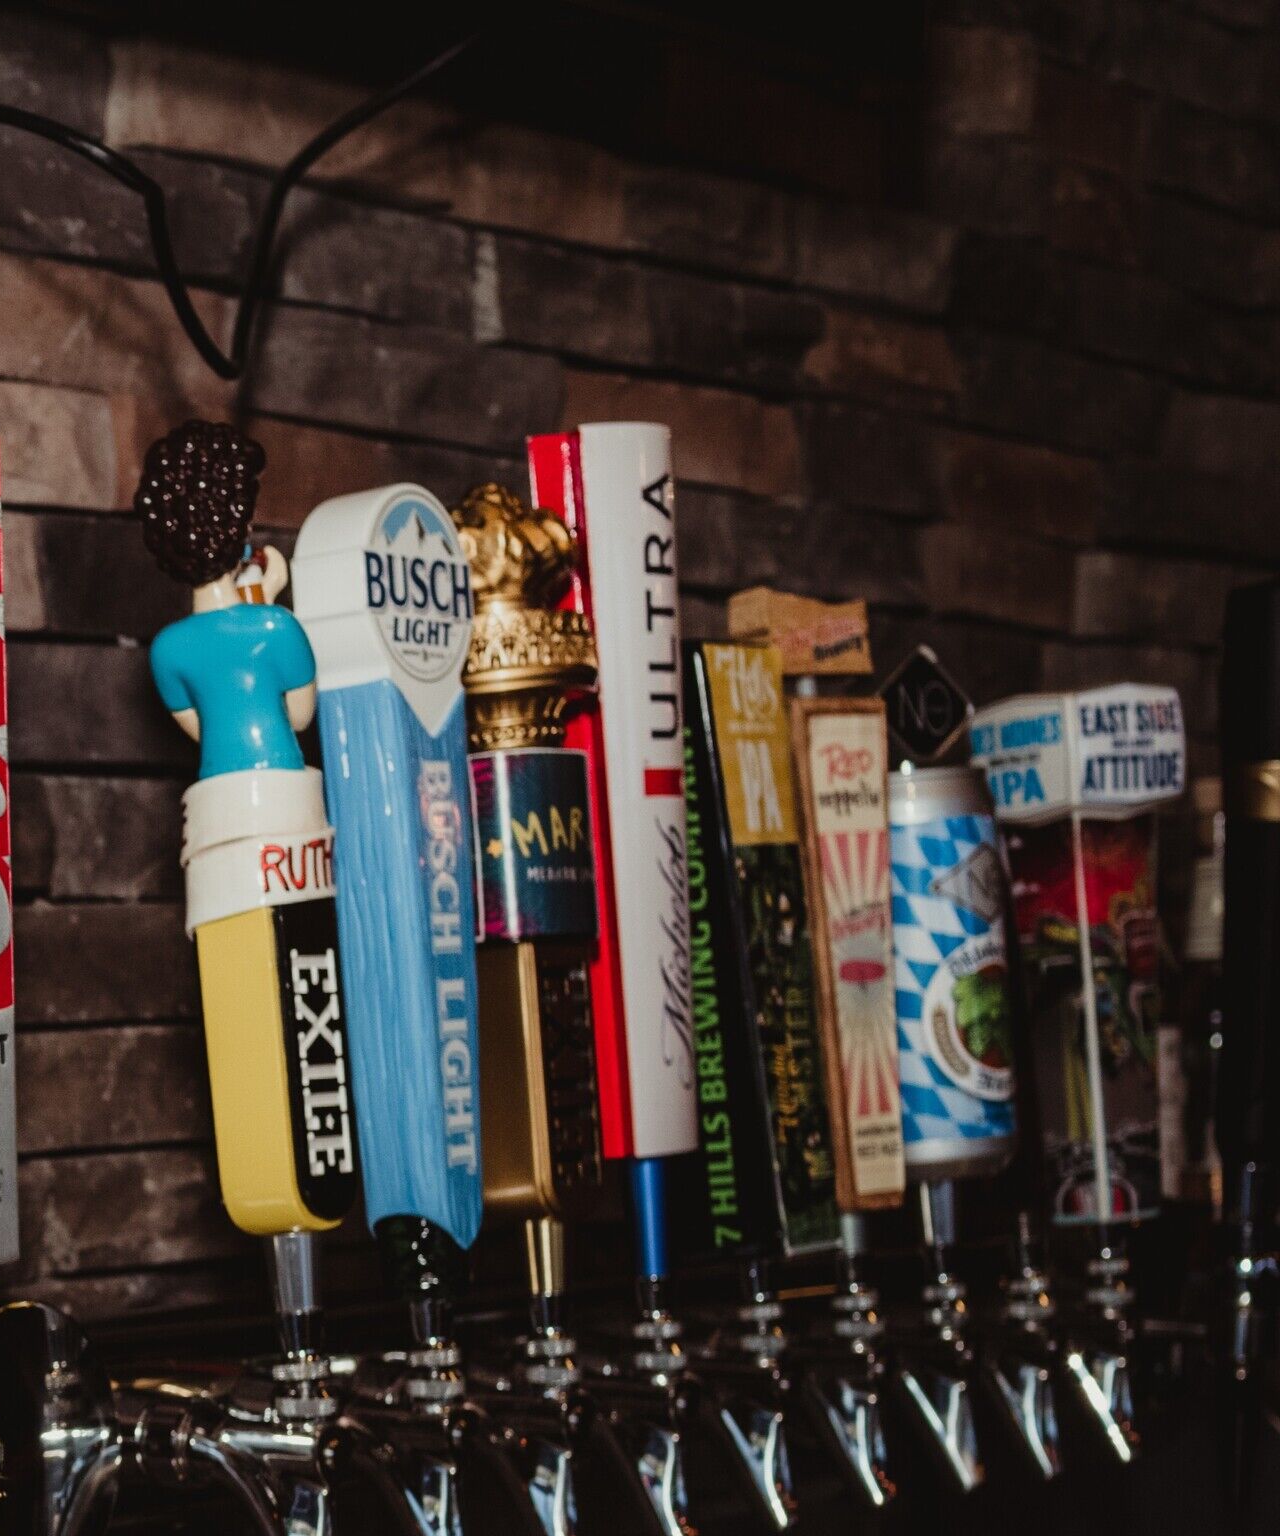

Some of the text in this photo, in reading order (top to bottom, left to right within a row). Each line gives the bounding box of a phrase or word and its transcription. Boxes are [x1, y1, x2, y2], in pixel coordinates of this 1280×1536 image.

[363, 550, 473, 620] BUSCH
[642, 473, 680, 739] ULTRA
[392, 616, 452, 650] LIGHT
[1080, 702, 1129, 737] EAST
[988, 766, 1046, 805] IPA
[1083, 749, 1181, 791] ATTITUDE
[420, 761, 478, 1176] BUSCH LIGHT
[656, 814, 695, 1091] Michelob
[689, 919, 728, 1104] BREWING
[290, 948, 354, 1177] EXILE
[703, 1112, 738, 1215] HILLS
[714, 1225, 742, 1248] 7
